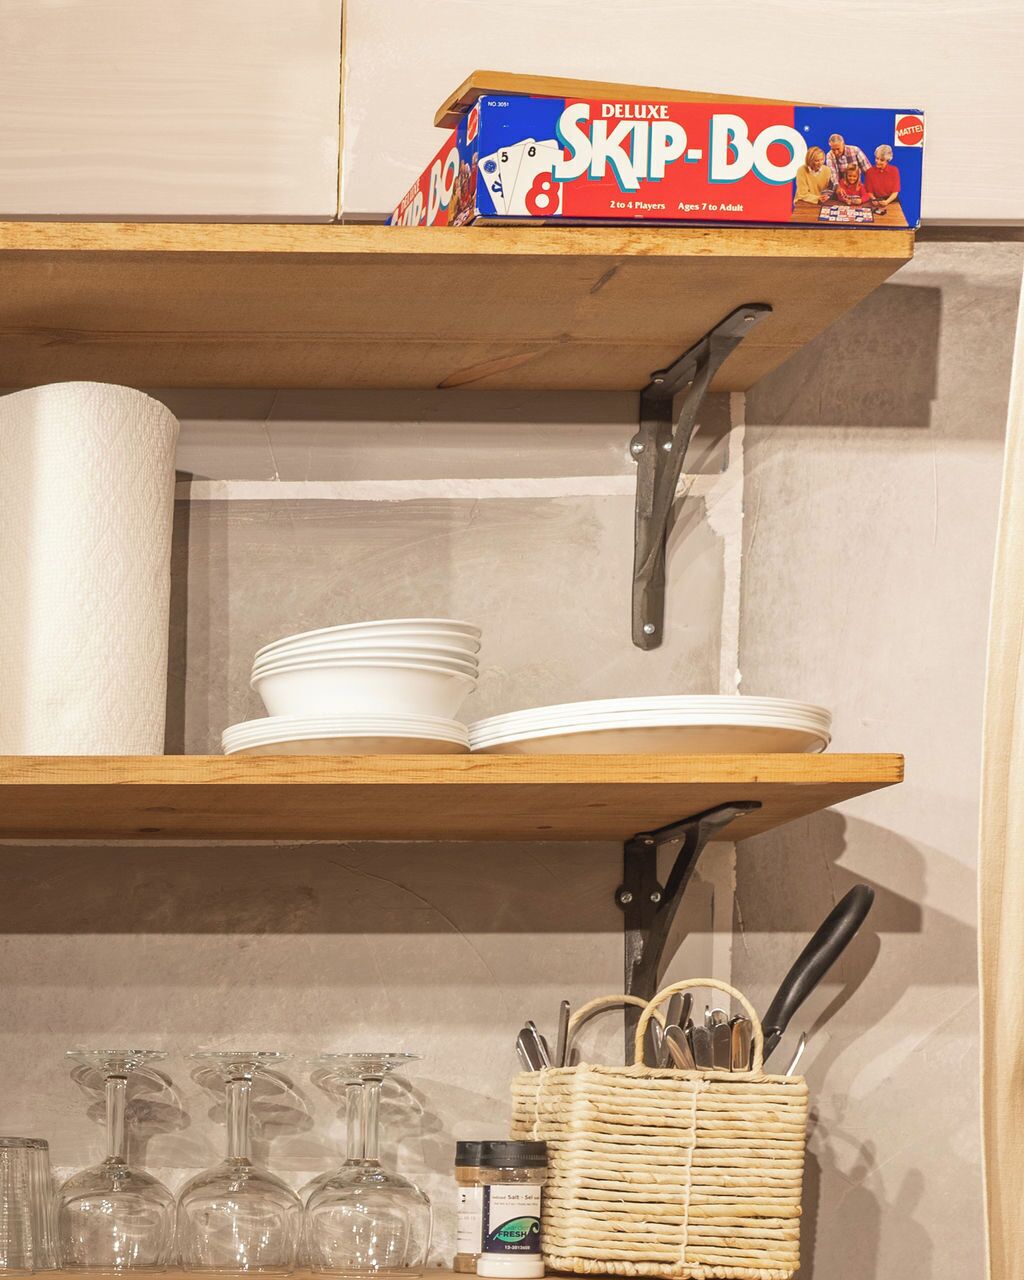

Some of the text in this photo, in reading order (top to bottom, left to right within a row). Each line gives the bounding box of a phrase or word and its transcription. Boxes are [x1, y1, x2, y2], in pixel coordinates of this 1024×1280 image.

[602, 104, 669, 119] DELUXE
[896, 124, 924, 137] MATTEL
[528, 146, 536, 157] 8
[552, 103, 807, 192] SKIP-BO
[501, 152, 508, 162] 5
[525, 172, 559, 216] 8
[610, 200, 616, 208] 2
[634, 202, 666, 211] Players
[678, 202, 699, 212] Ages
[708, 203, 717, 211] to
[719, 204, 743, 212] Adult
